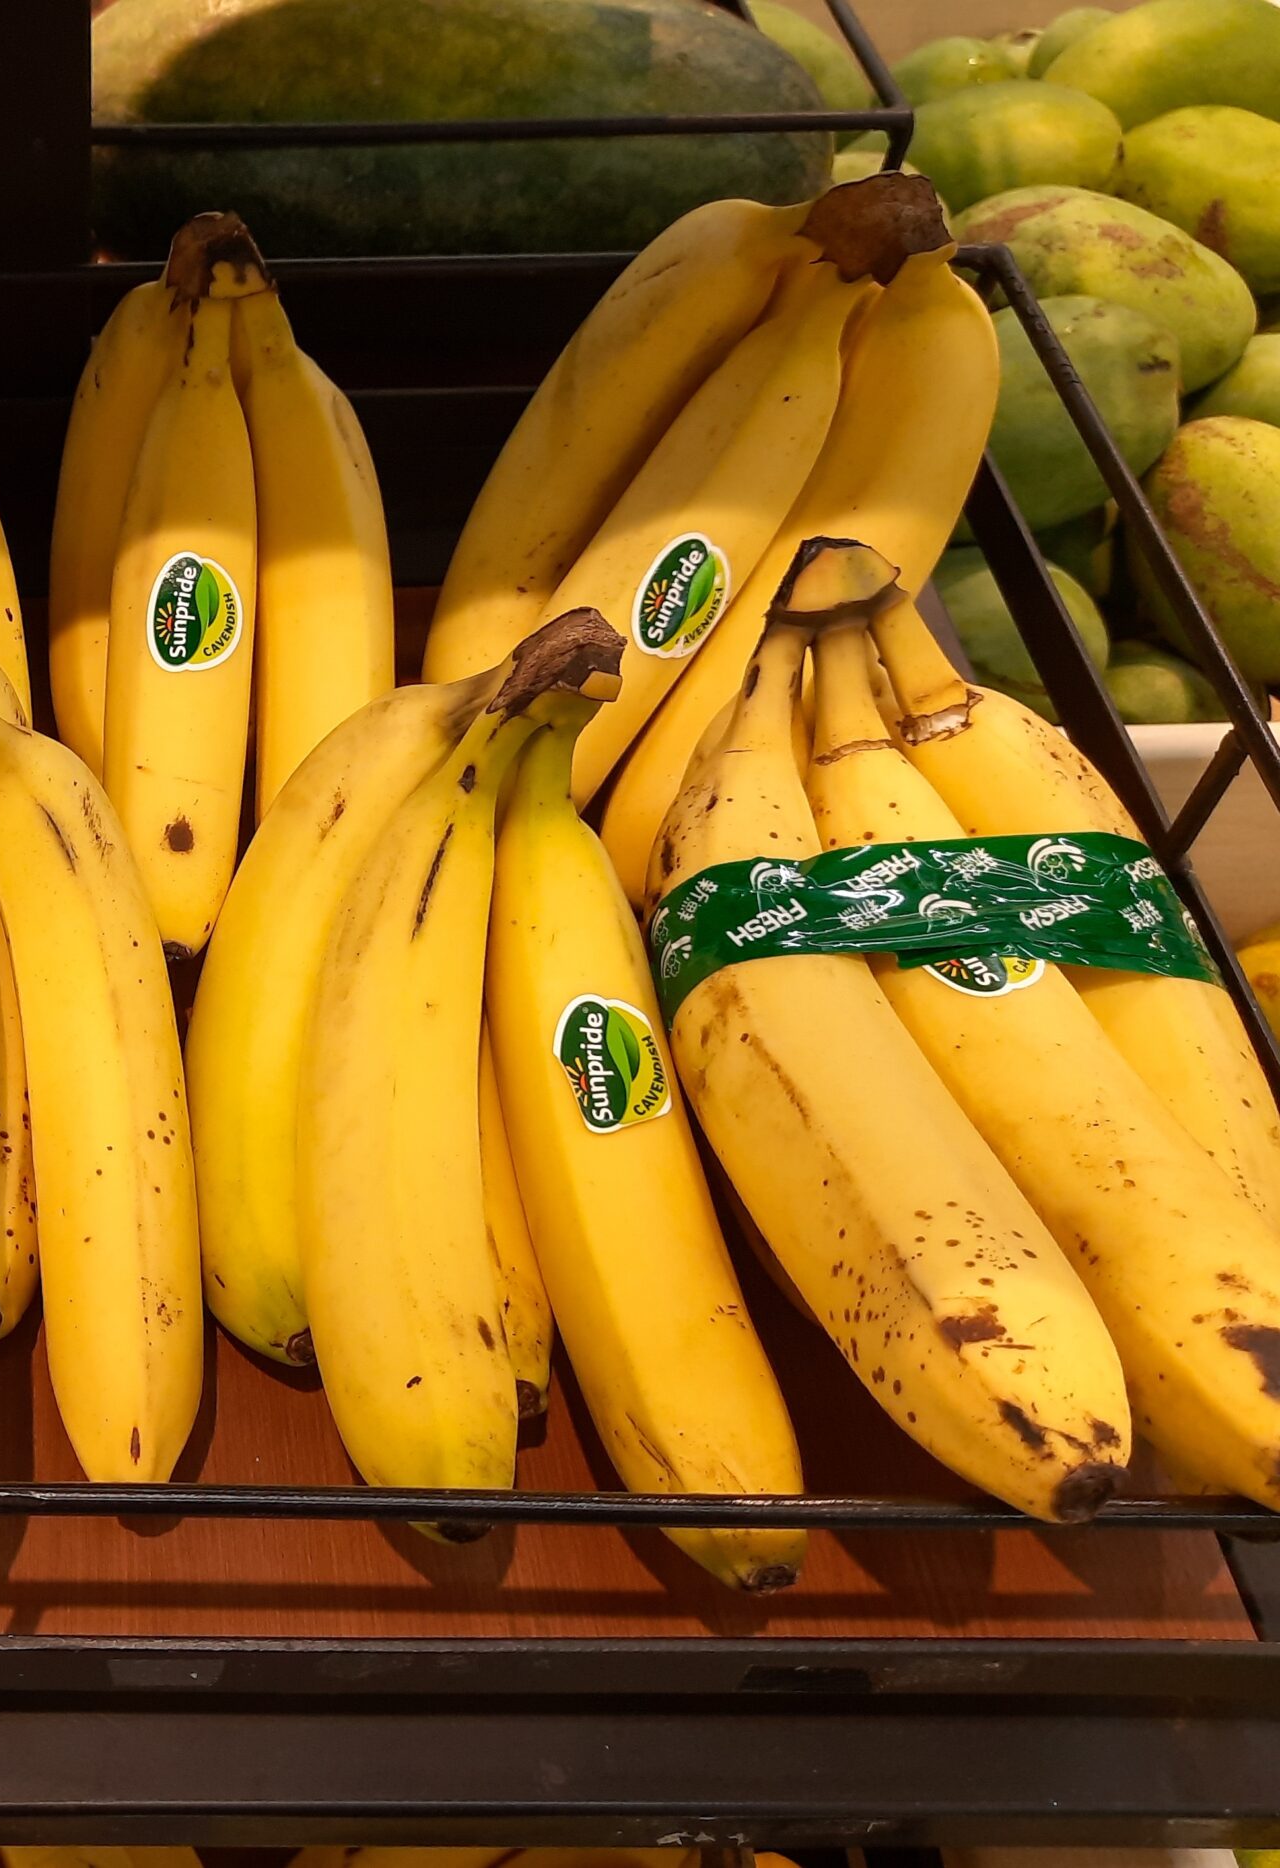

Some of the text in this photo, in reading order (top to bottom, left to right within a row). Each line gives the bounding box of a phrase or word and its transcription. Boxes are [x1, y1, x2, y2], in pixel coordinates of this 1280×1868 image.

[169, 567, 197, 657] Sunpride
[203, 593, 235, 656] CAVENDISH
[648, 549, 704, 641] Sunpride
[677, 878, 718, 921] 新鮮
[846, 848, 921, 891] FRESH
[726, 898, 807, 947] FRESH
[1020, 895, 1090, 931] FRESH
[579, 1012, 614, 1121] Sunpride
[633, 1035, 666, 1116] CAVENDISH
